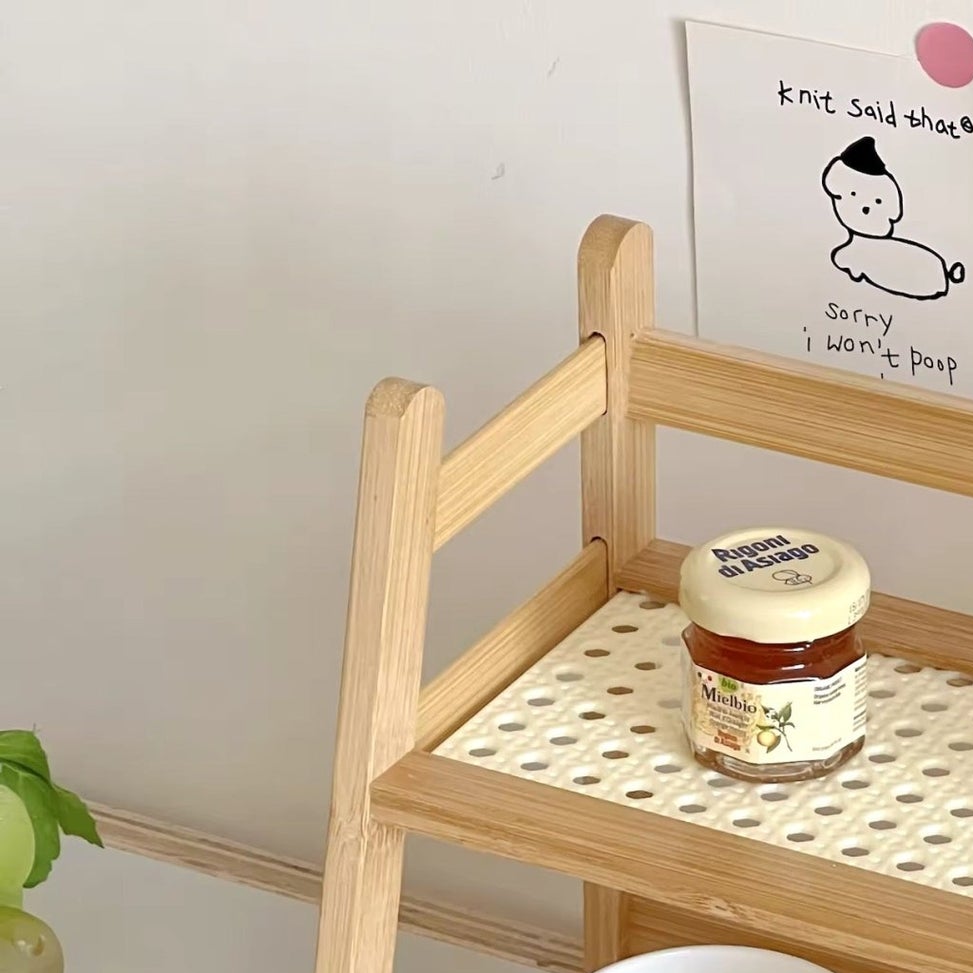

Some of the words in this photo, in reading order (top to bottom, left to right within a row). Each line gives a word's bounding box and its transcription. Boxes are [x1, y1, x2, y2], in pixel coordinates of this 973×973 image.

[777, 80, 836, 114] knit
[910, 345, 958, 386] poop
[711, 534, 791, 562] Rigoni
[718, 564, 744, 578] di
[741, 544, 820, 572] Asiago
[701, 683, 757, 714] Mielbio
